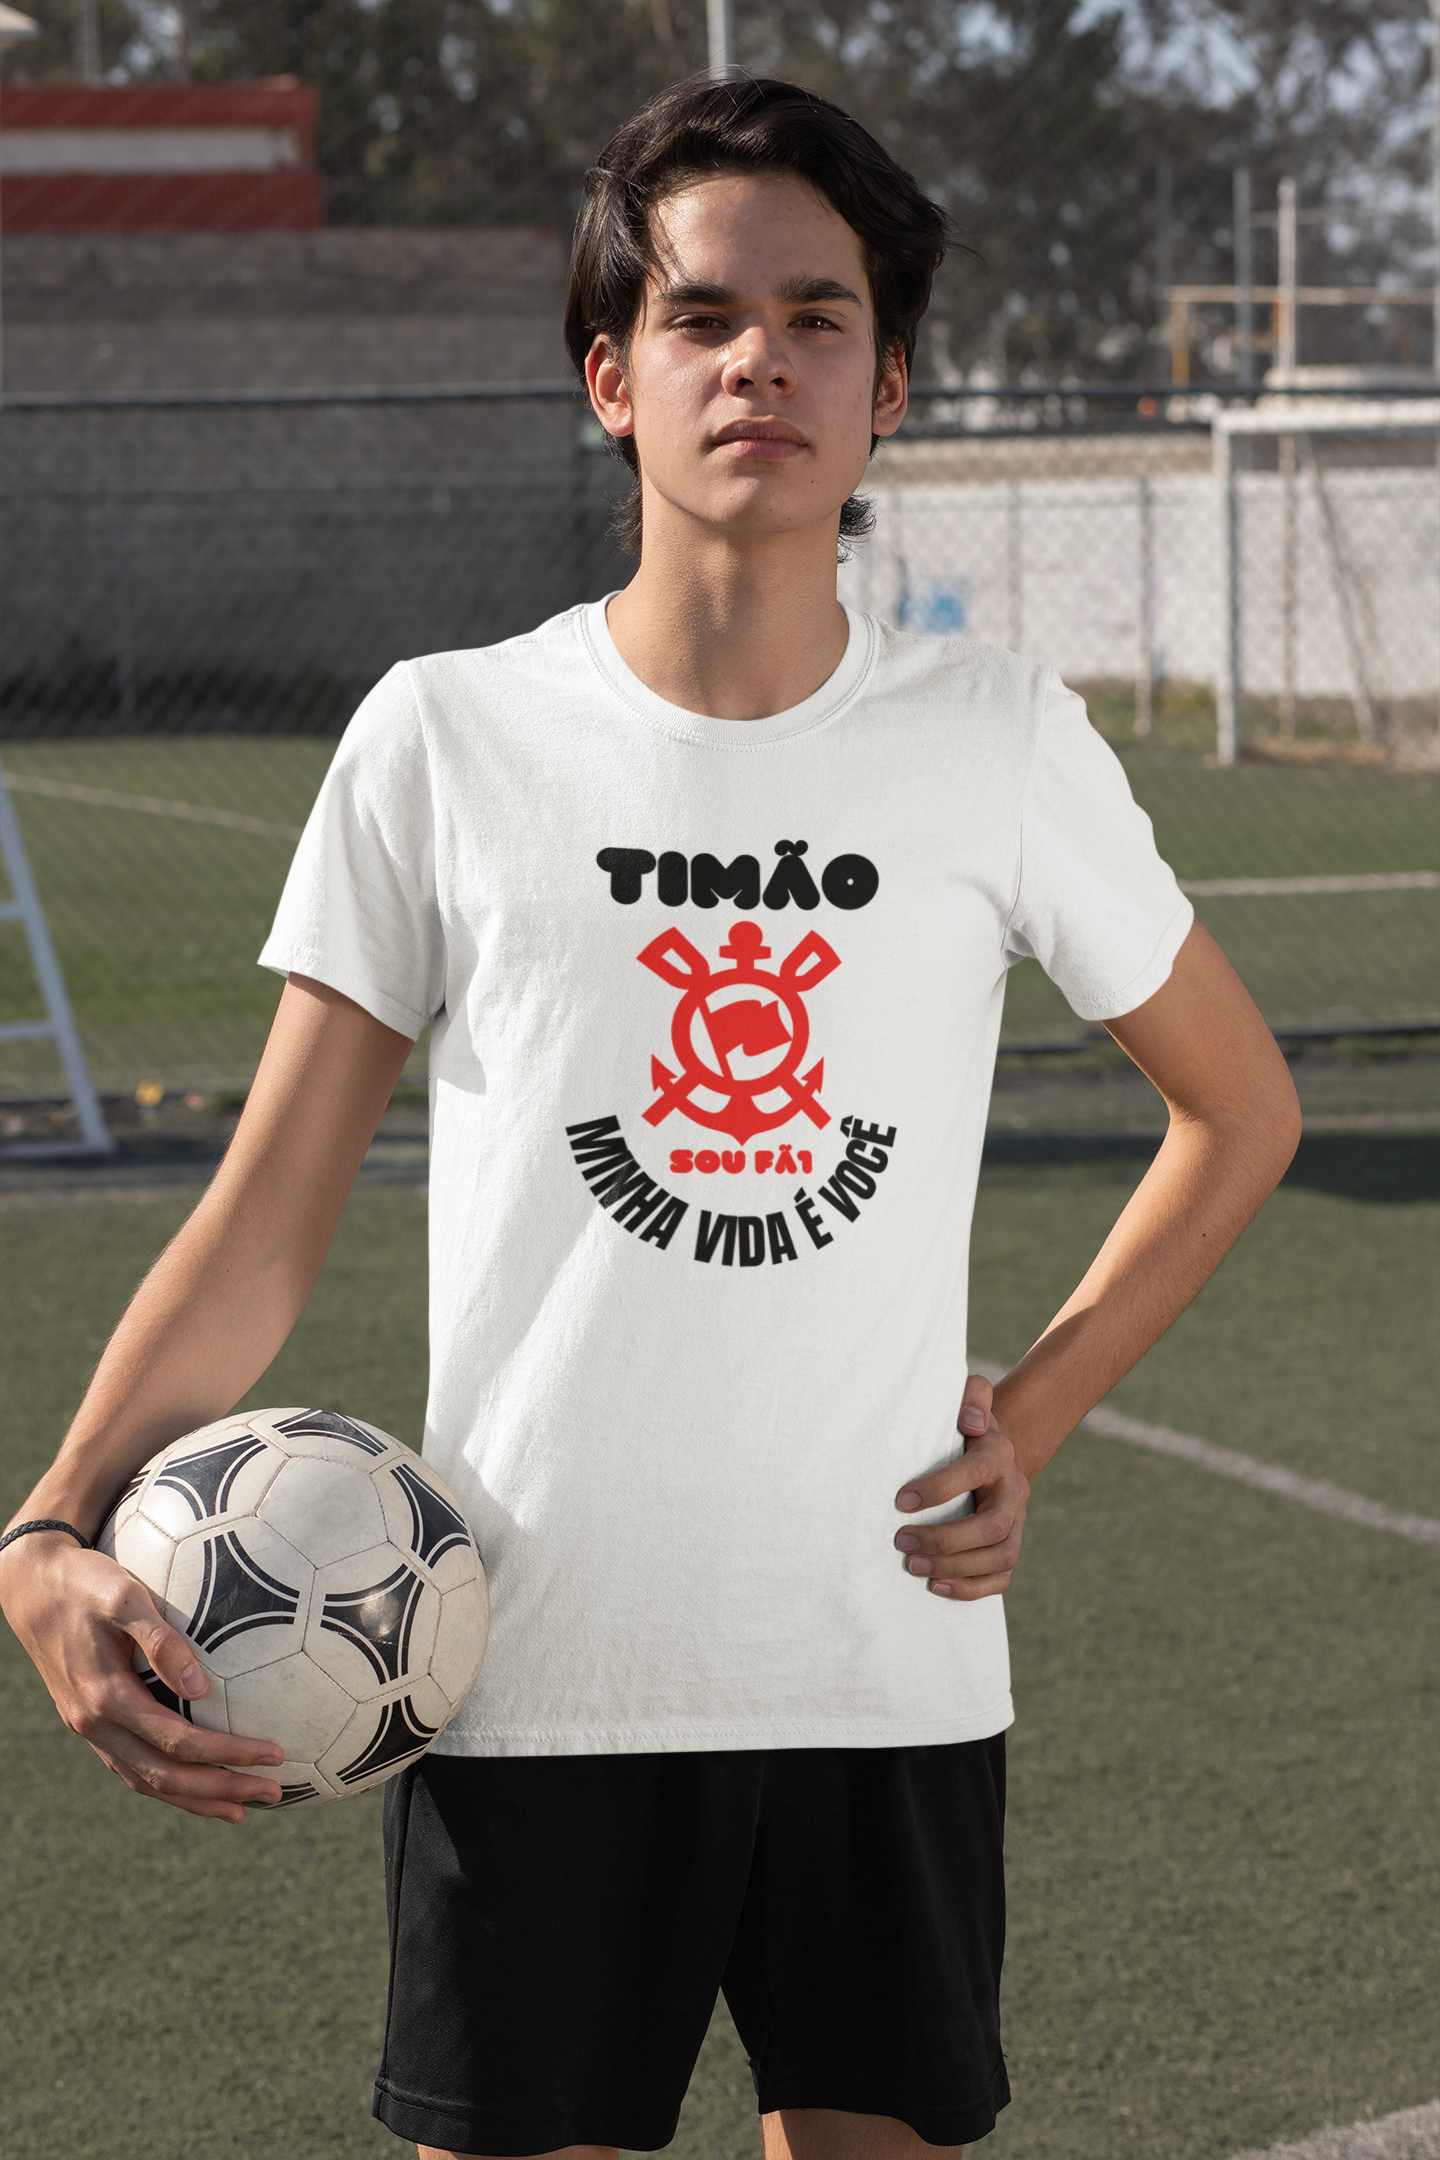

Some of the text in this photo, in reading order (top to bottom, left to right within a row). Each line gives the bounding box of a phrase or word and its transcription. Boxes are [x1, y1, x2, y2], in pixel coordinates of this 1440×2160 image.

[596, 839, 880, 911] TIMÃO
[565, 1114, 897, 1268] MINHA VIDA É VOCÊ
[669, 1149, 746, 1175] SOU
